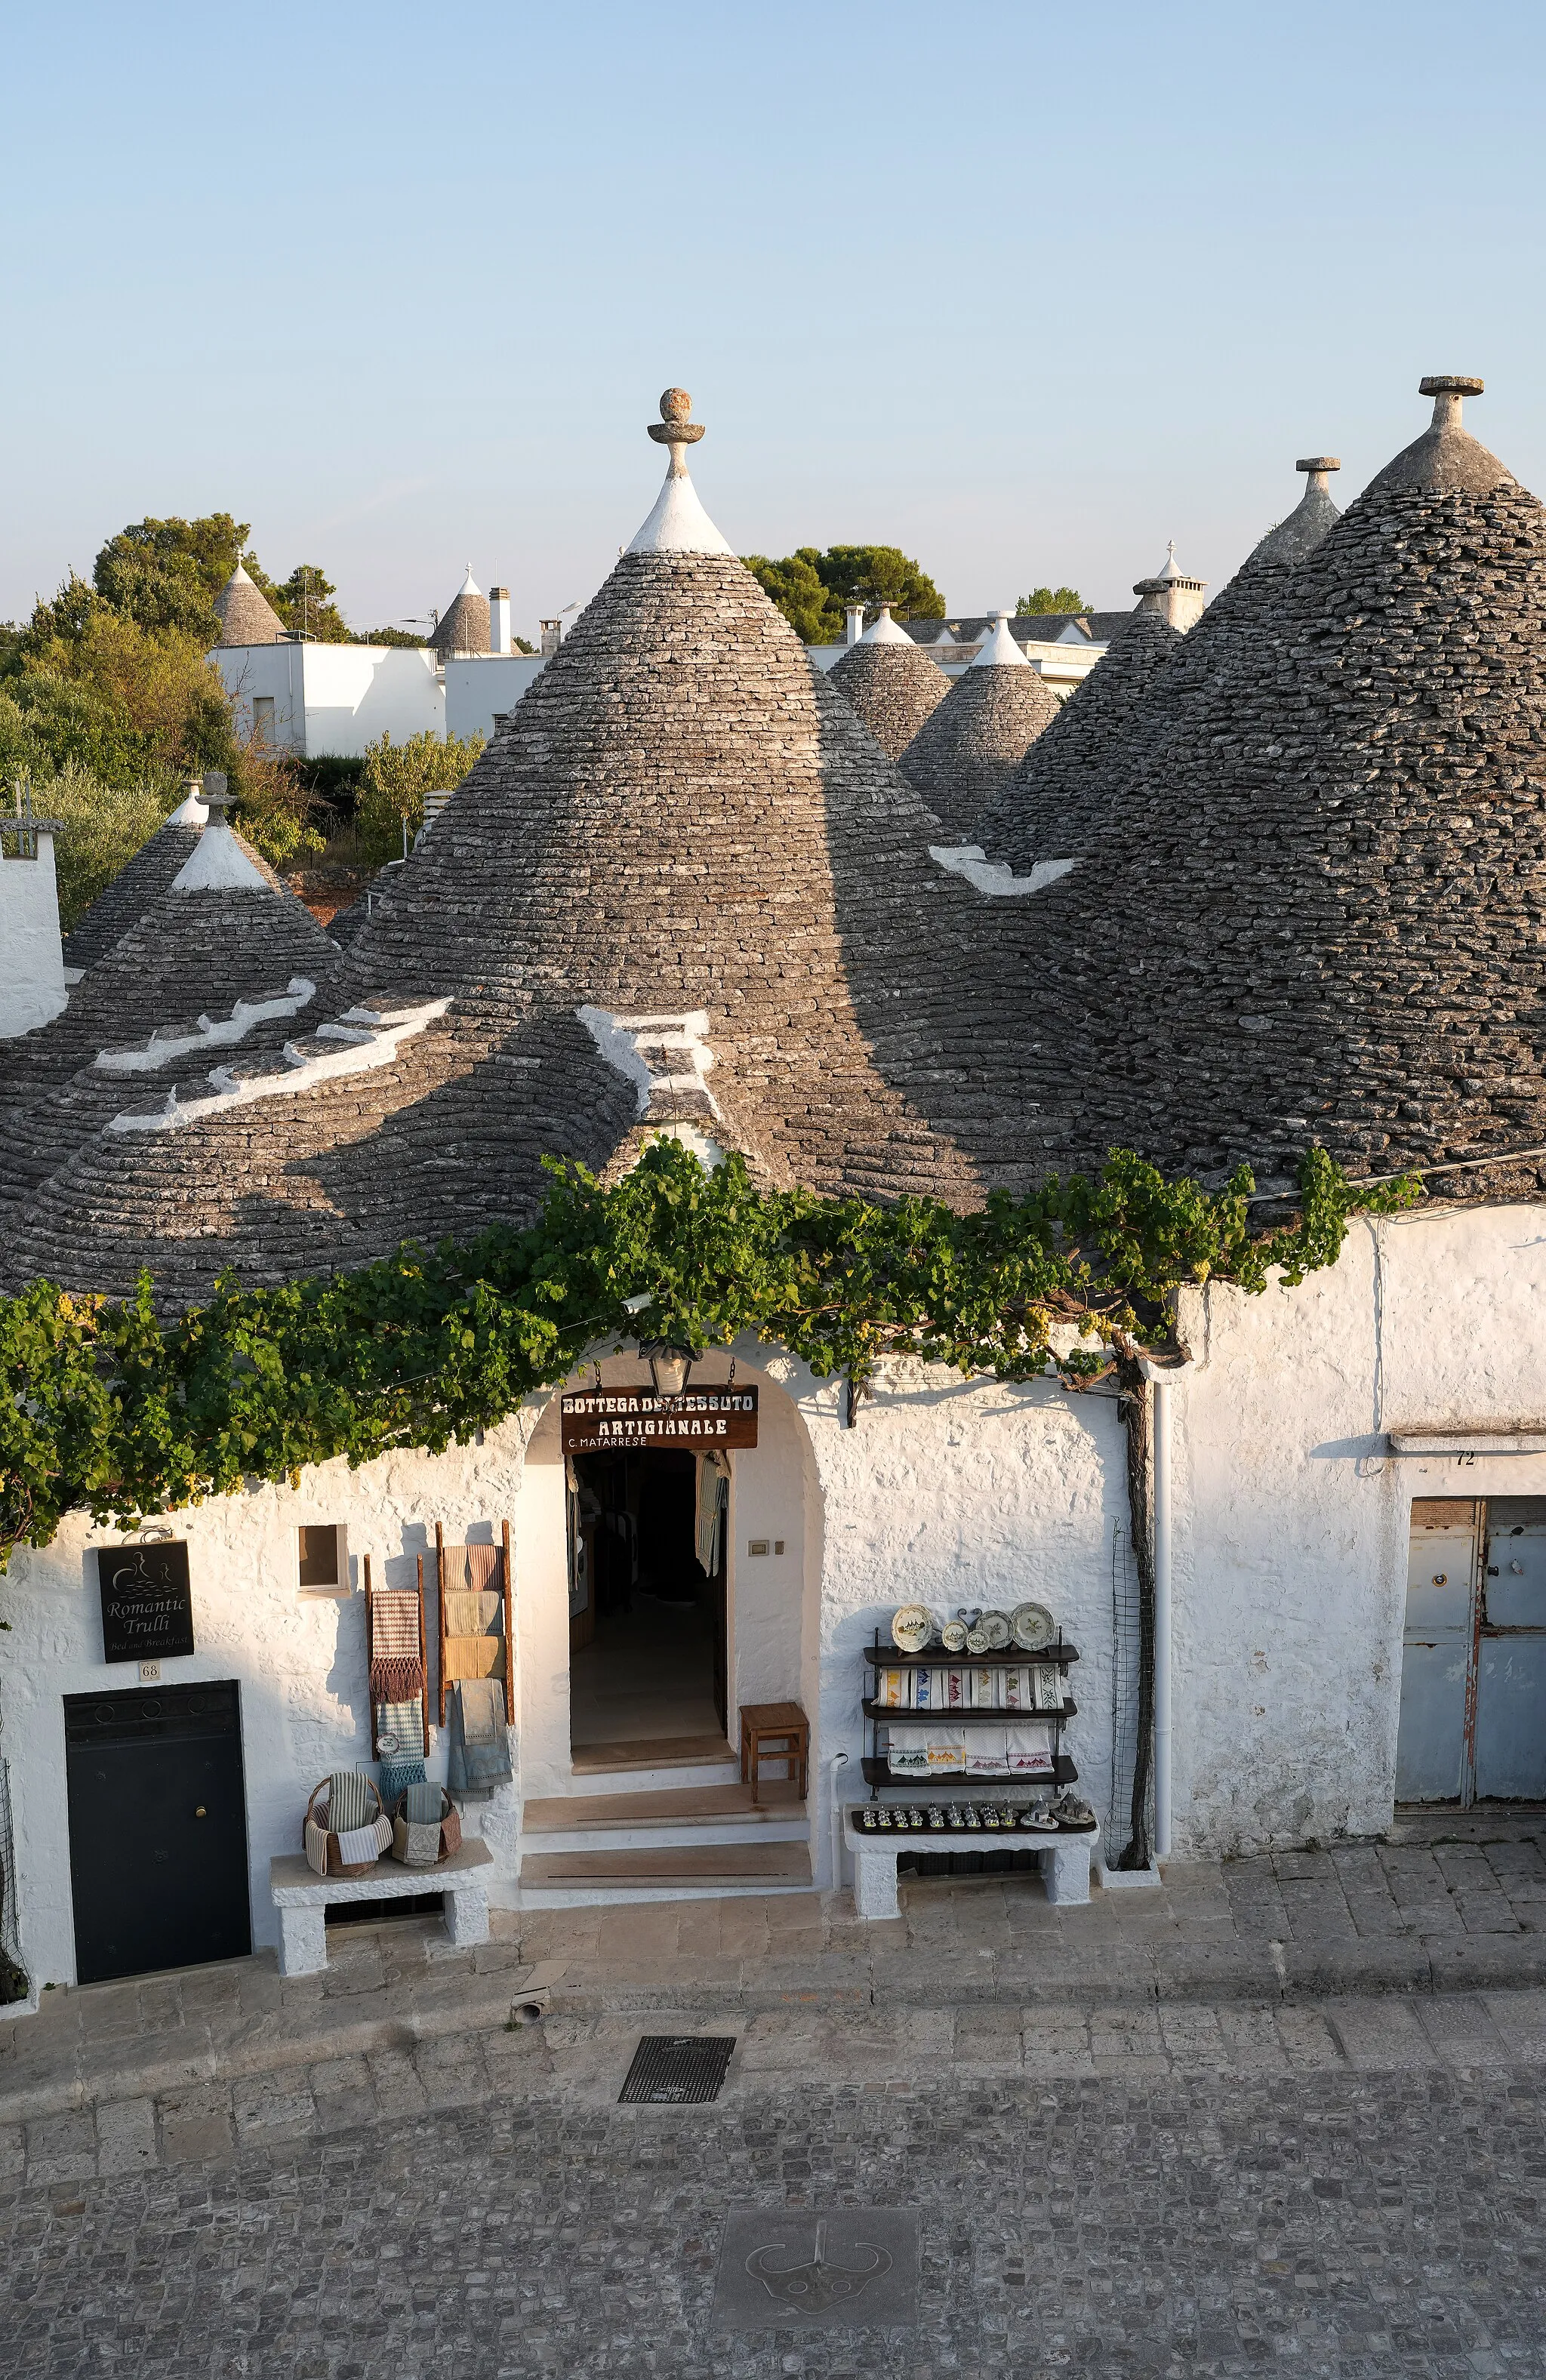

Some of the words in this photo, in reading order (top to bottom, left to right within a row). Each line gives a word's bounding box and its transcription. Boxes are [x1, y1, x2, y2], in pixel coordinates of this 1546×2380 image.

[562, 1397, 639, 1414] BOTTEGA
[675, 1396, 753, 1412] TESSUTO
[599, 1420, 727, 1436] ARTIGIANALE
[568, 1439, 577, 1448] C.
[580, 1436, 647, 1447] MATARRESE
[1456, 1450, 1475, 1466] 72
[107, 1595, 186, 1620] Romantic
[123, 1615, 170, 1634] Trulli
[109, 1640, 127, 1652] Bed
[128, 1640, 143, 1649] and
[144, 1636, 188, 1649] Breakfast
[143, 1665, 158, 1676] 68
